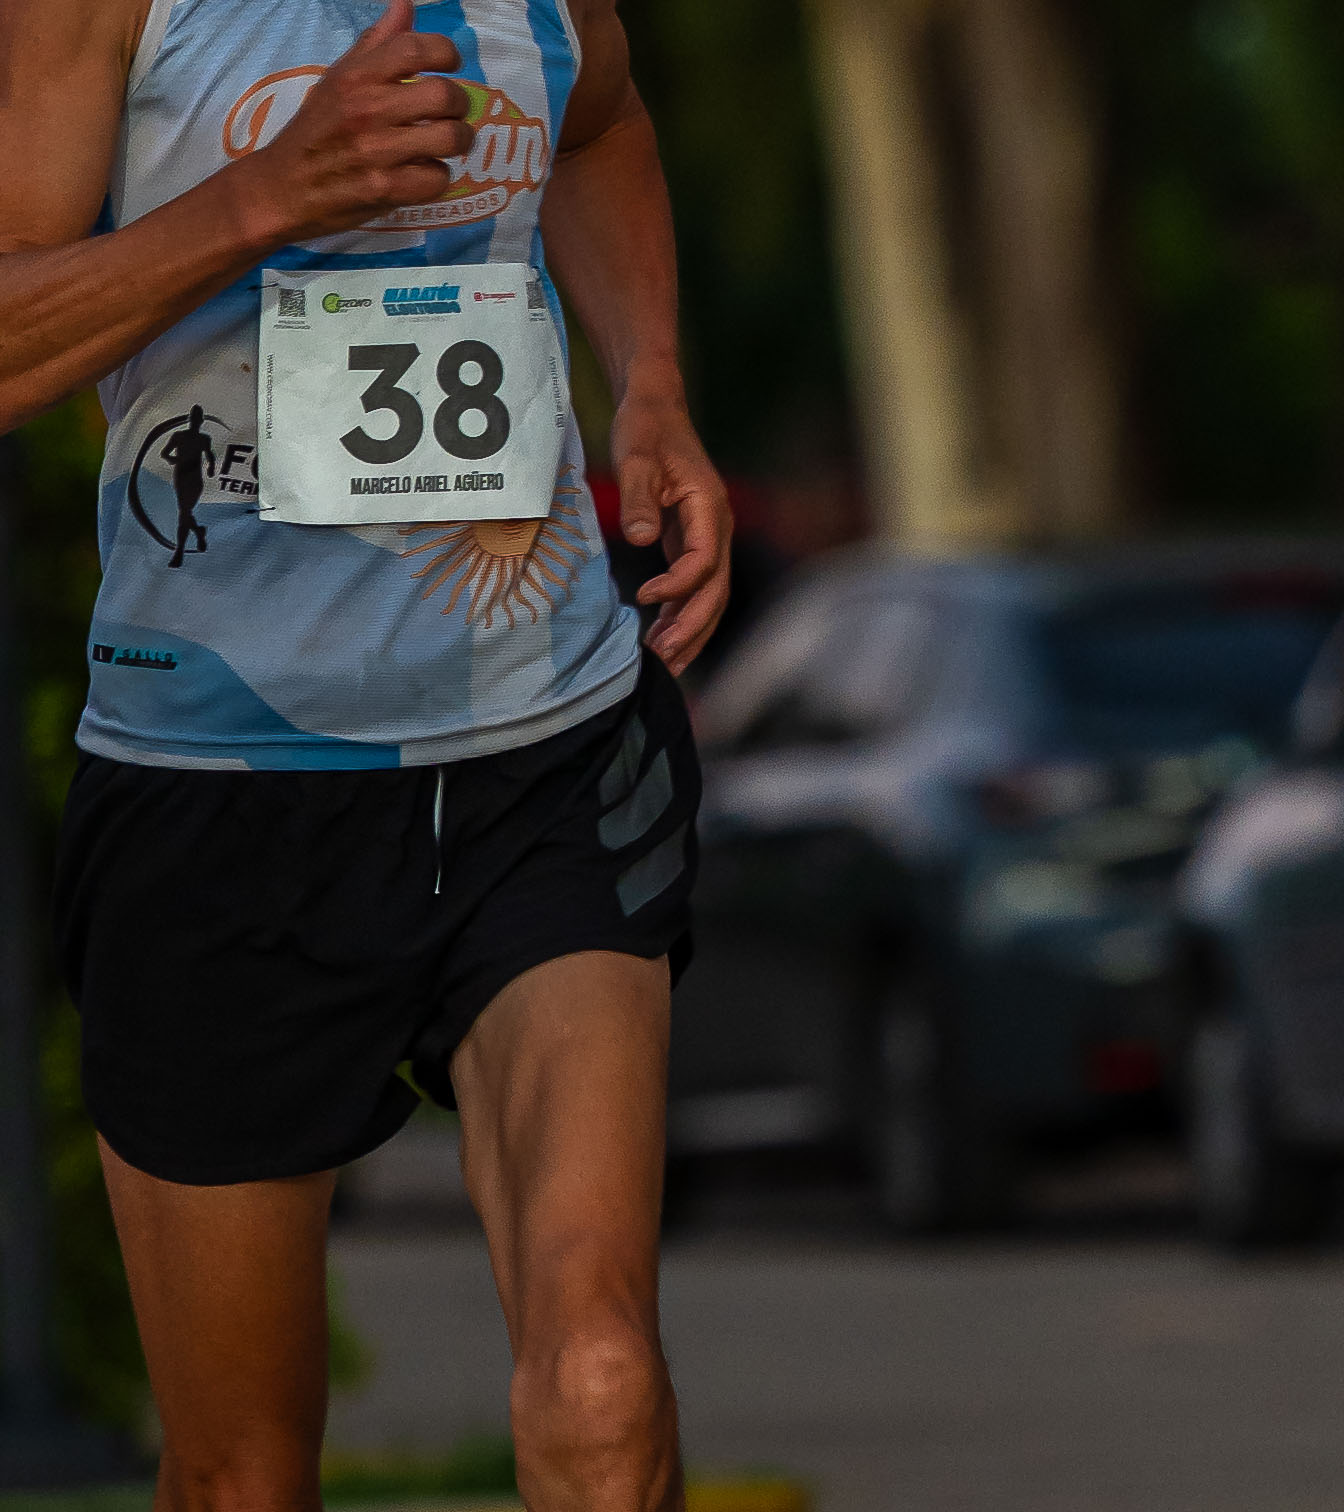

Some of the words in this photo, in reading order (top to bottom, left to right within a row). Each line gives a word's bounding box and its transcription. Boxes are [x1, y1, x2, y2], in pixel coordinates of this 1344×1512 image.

[339, 339, 511, 465] 38
[220, 444, 258, 479] F
[218, 477, 259, 495] TEA
[350, 476, 411, 495] MARCELO
[414, 475, 451, 493] ARIEL
[453, 471, 504, 491] AGÜERO
